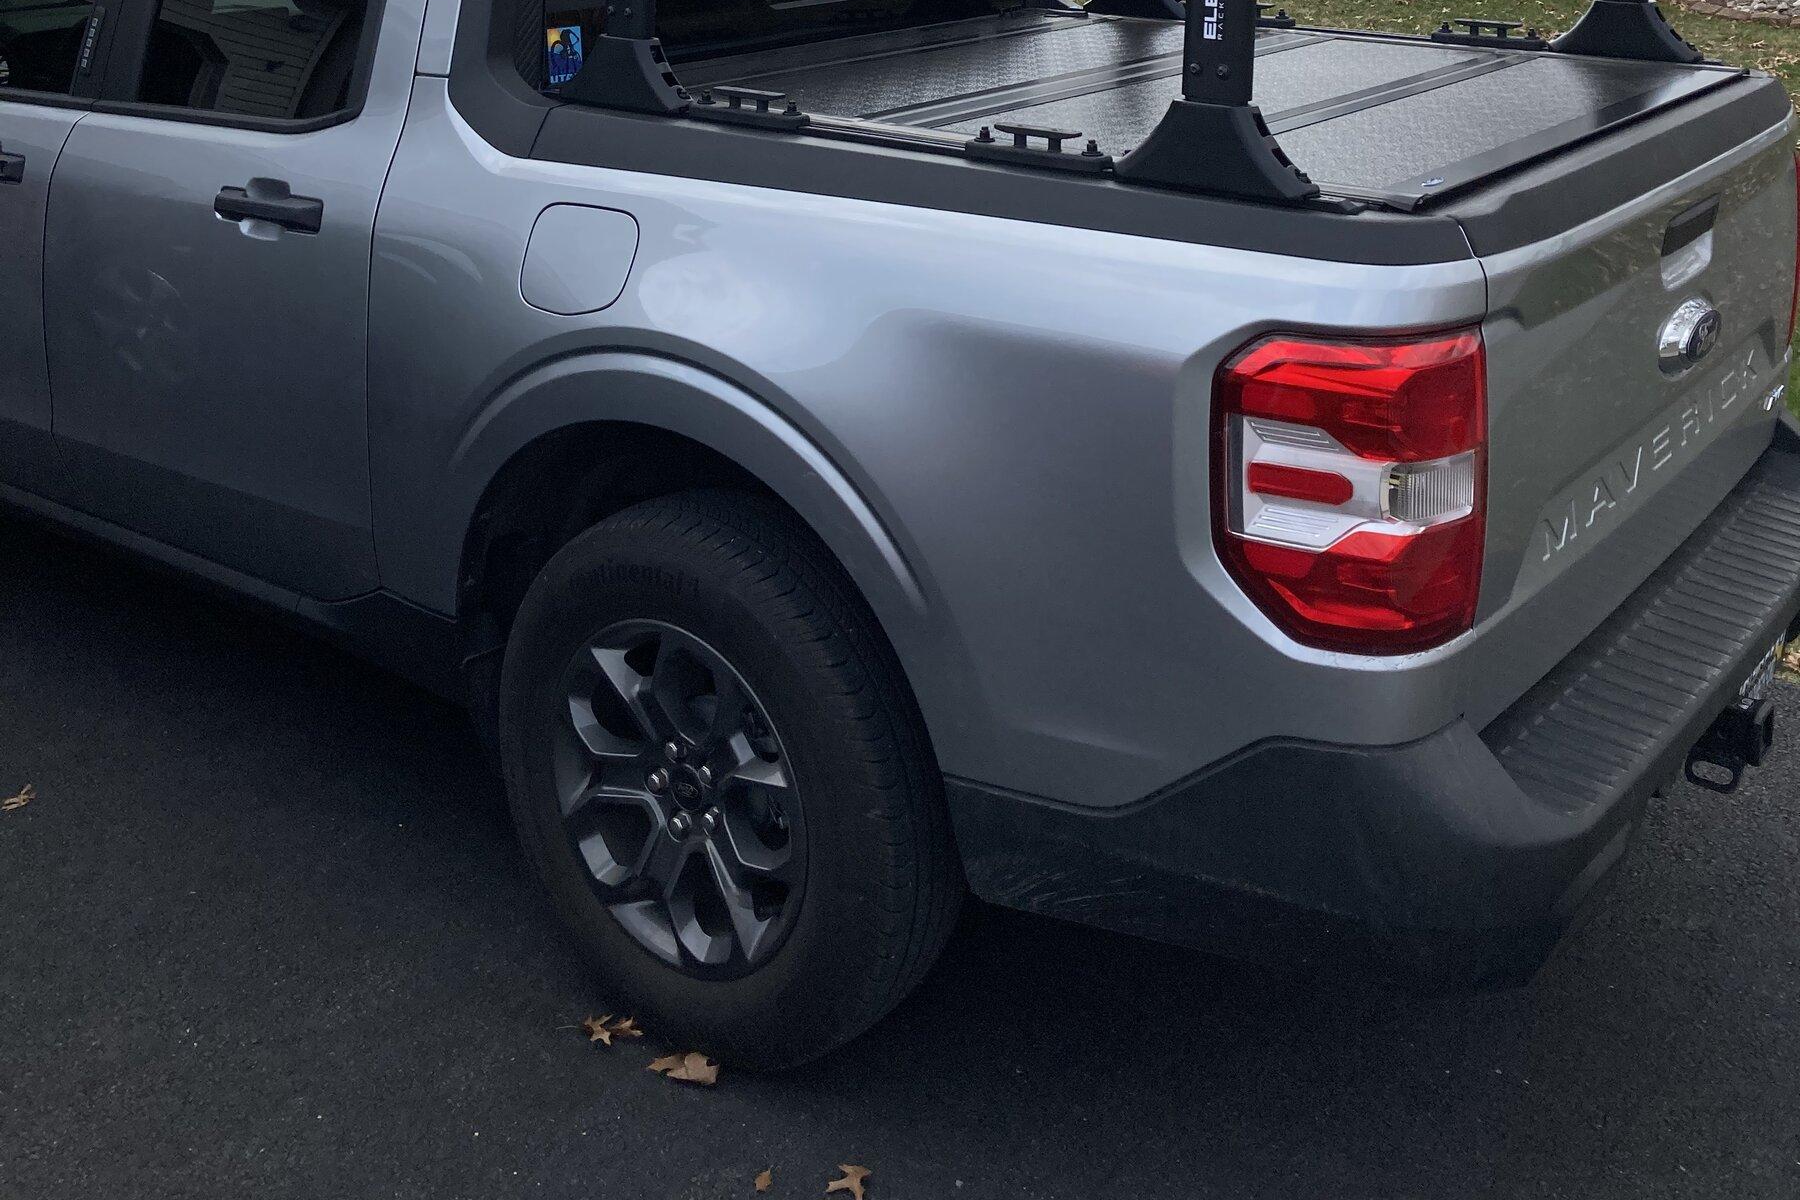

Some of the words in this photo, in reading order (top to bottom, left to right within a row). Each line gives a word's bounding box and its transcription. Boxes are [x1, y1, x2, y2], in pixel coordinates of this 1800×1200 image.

[1217, 2, 1225, 41] RACK
[550, 73, 577, 84] UTA
[1542, 349, 1758, 562] MAVERICK
